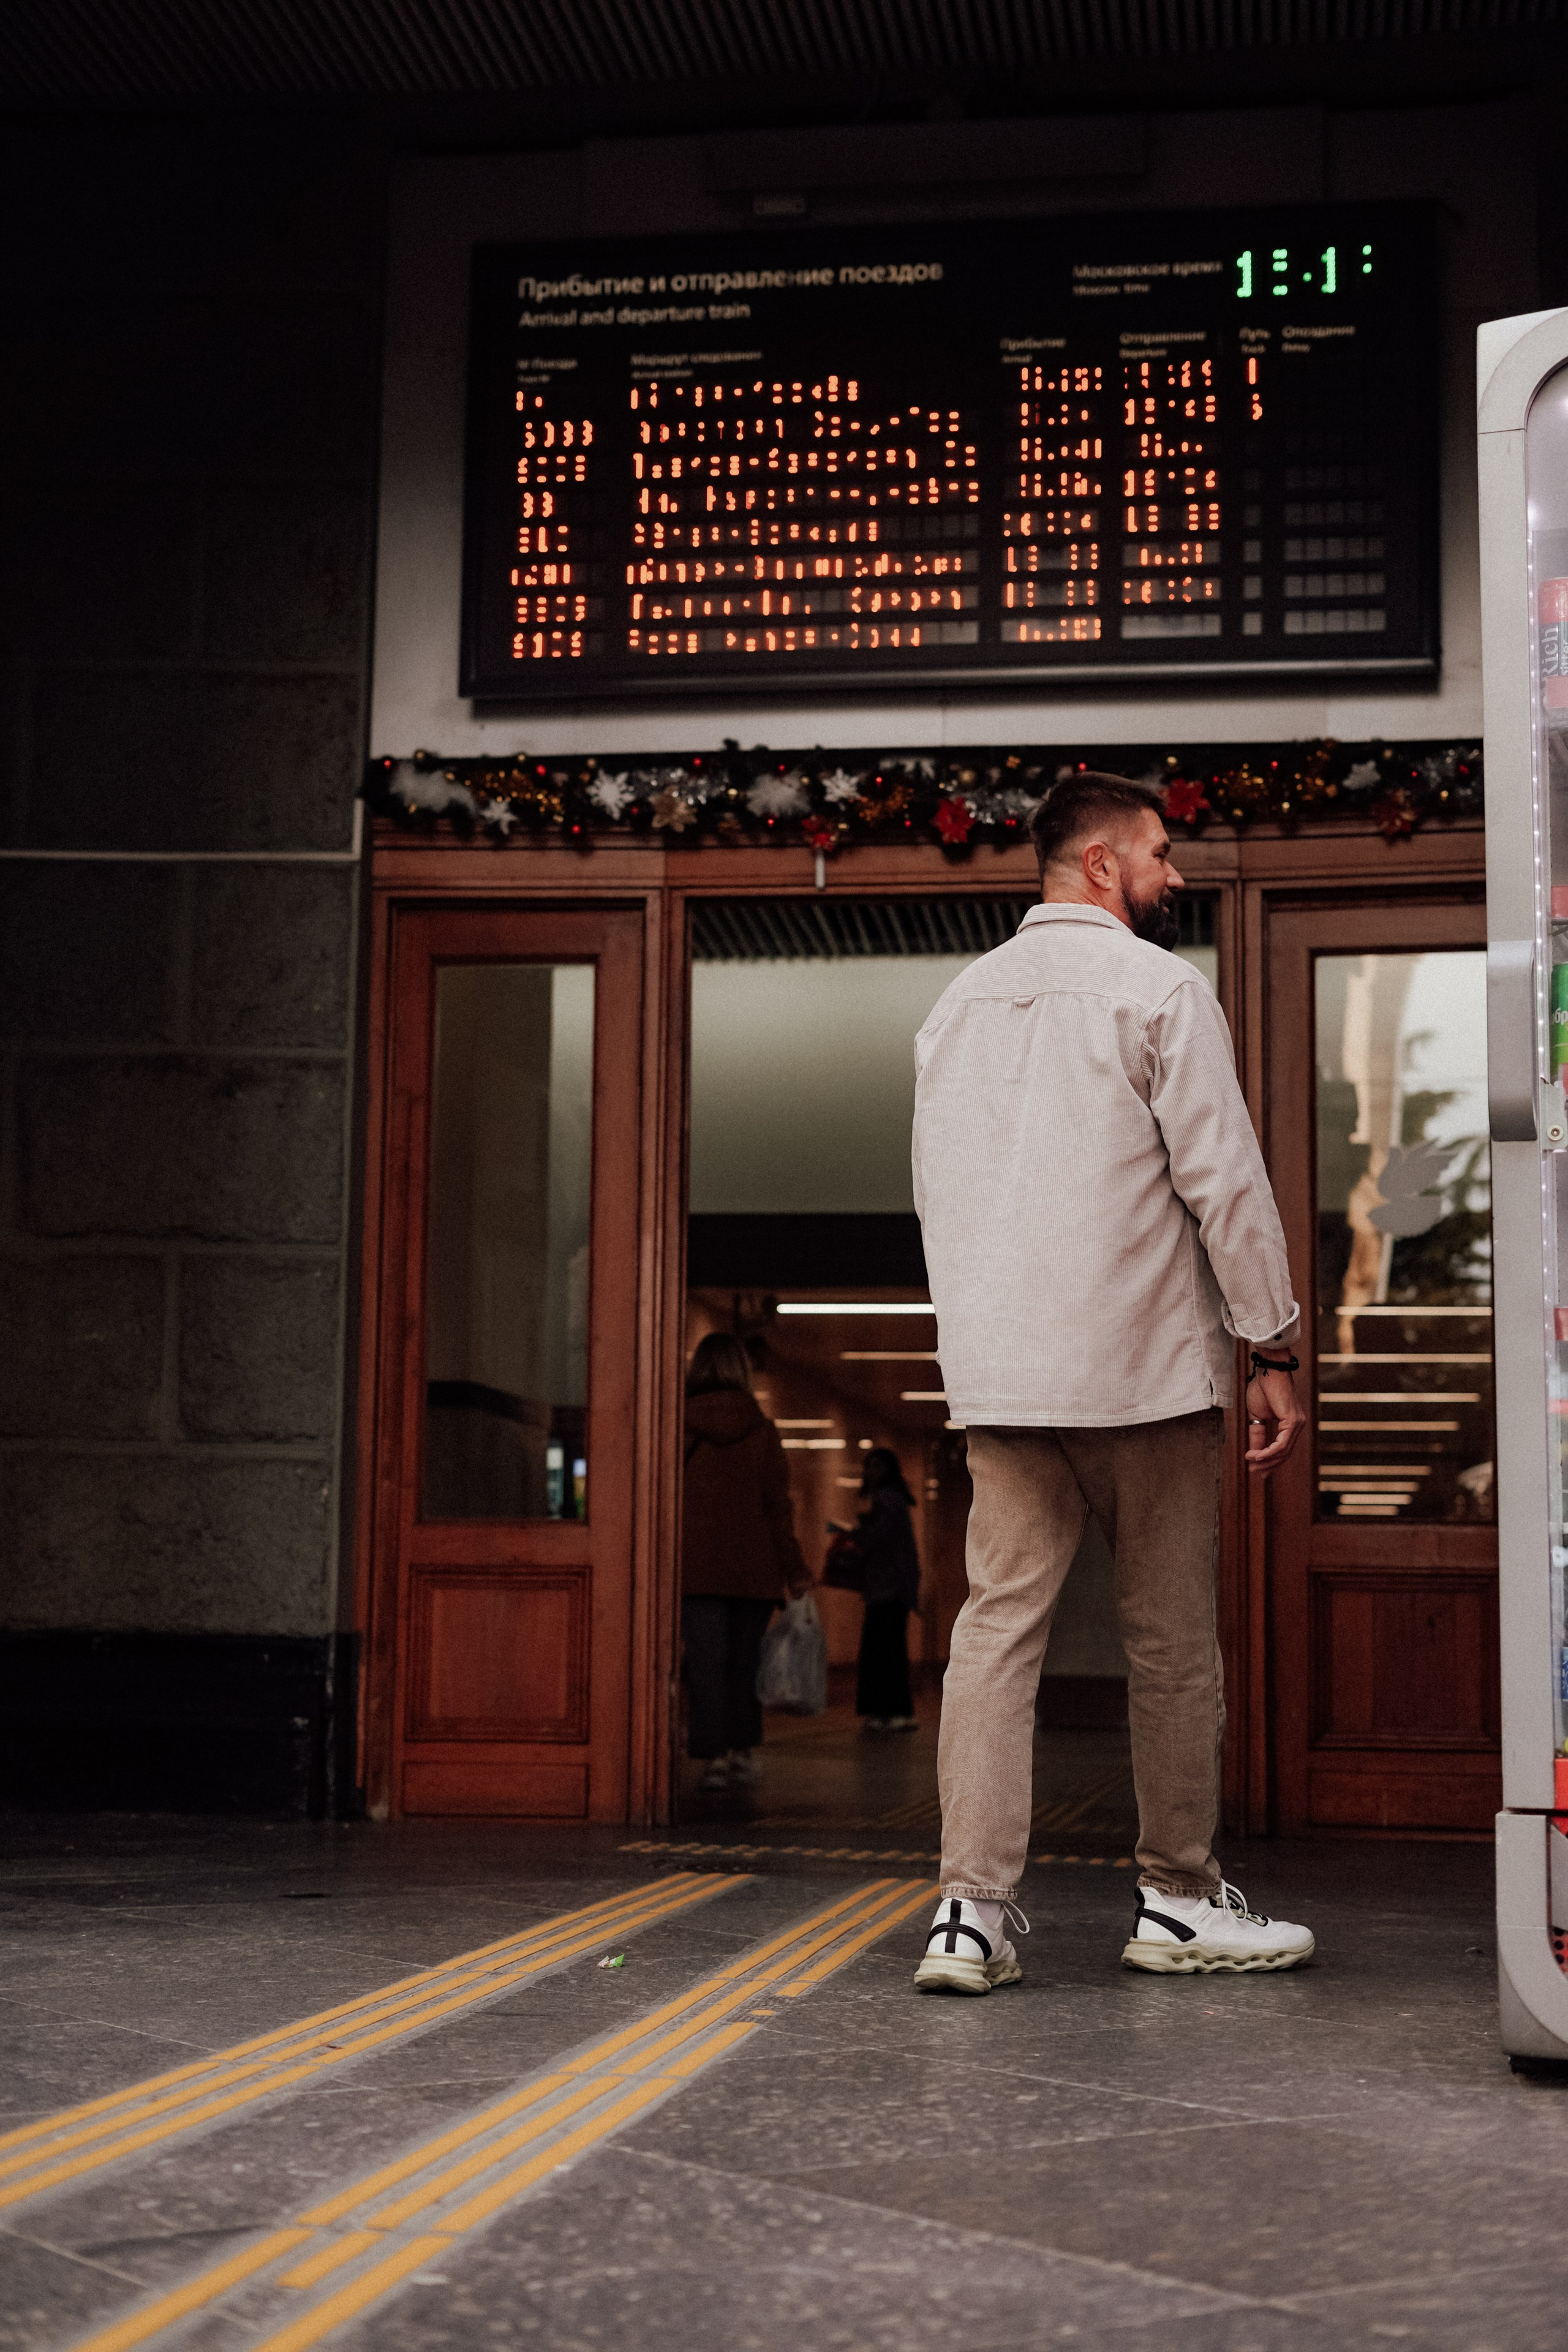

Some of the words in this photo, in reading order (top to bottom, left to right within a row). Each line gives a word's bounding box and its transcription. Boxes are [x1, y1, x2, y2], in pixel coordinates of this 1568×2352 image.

[1172, 261, 1224, 276] время
[518, 273, 644, 303] Прибытие
[649, 276, 666, 293] и
[671, 268, 834, 295] отправление
[839, 263, 944, 285] поездов
[519, 308, 578, 328] Arrival
[579, 307, 614, 326] and
[616, 306, 706, 326] departure
[708, 302, 752, 320] train
